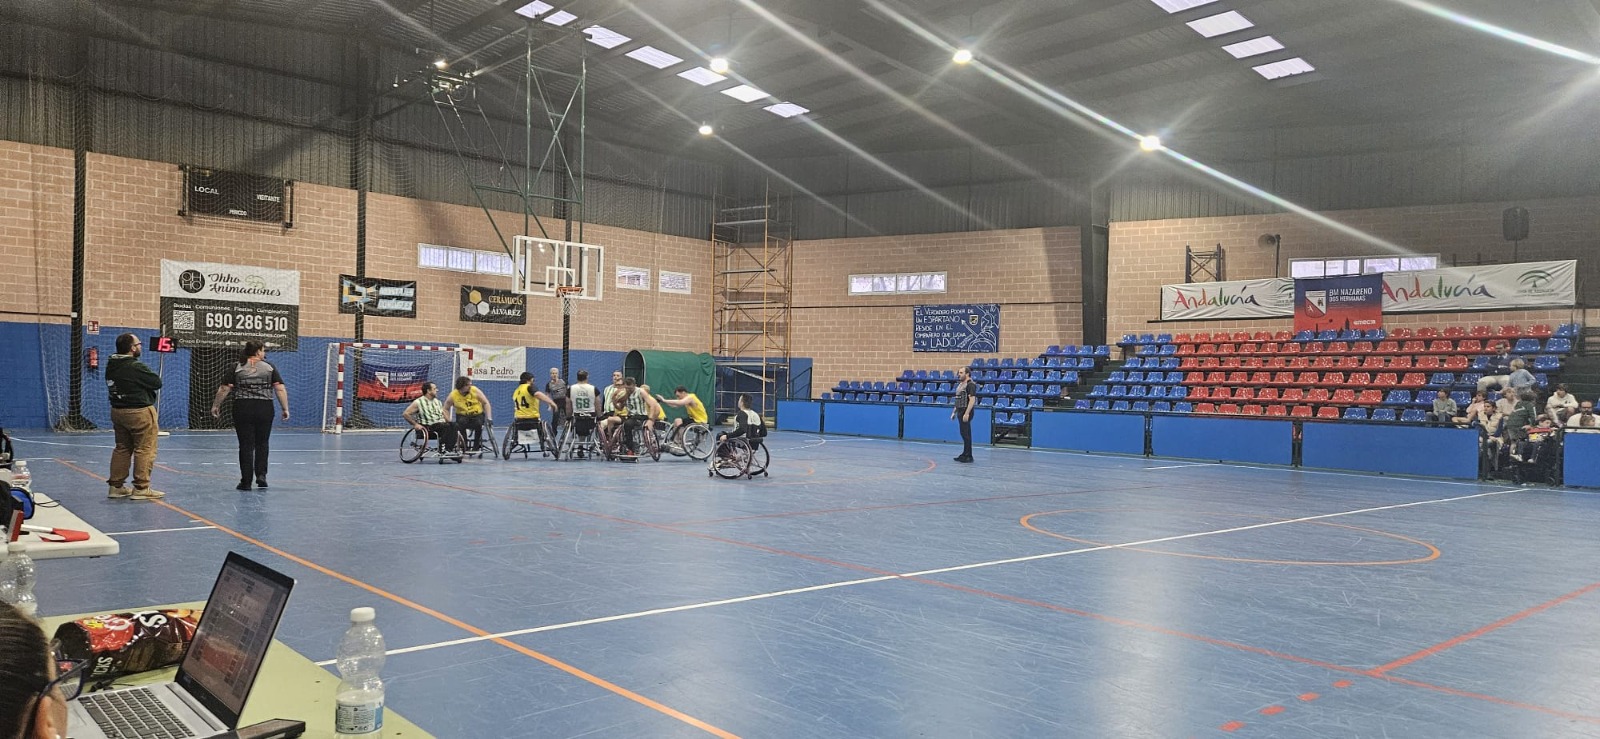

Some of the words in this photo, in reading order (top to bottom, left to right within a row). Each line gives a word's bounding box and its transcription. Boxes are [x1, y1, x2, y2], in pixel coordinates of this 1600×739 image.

[194, 186, 219, 195] LOCAL
[208, 273, 240, 284] Ohho
[209, 283, 281, 296] Animaciones
[1340, 287, 1373, 295] NAZARENO
[1381, 273, 1496, 303] Andalucía
[488, 294, 523, 305] CERÁMICAS
[1173, 284, 1262, 310] Andalucía
[491, 306, 522, 317] ÁLVAREZ
[205, 312, 233, 329] 690
[235, 314, 263, 330] 286
[265, 316, 288, 332] 510
[924, 315, 960, 323] ESPARTANO
[205, 329, 287, 339] www.ohhoanimaciones.com
[914, 331, 941, 339] COMPAÑERO
[158, 338, 171, 352] 15
[930, 338, 957, 348] LADO
[490, 366, 514, 375] Pedro
[514, 395, 530, 411] 14
[575, 397, 591, 409] 68
